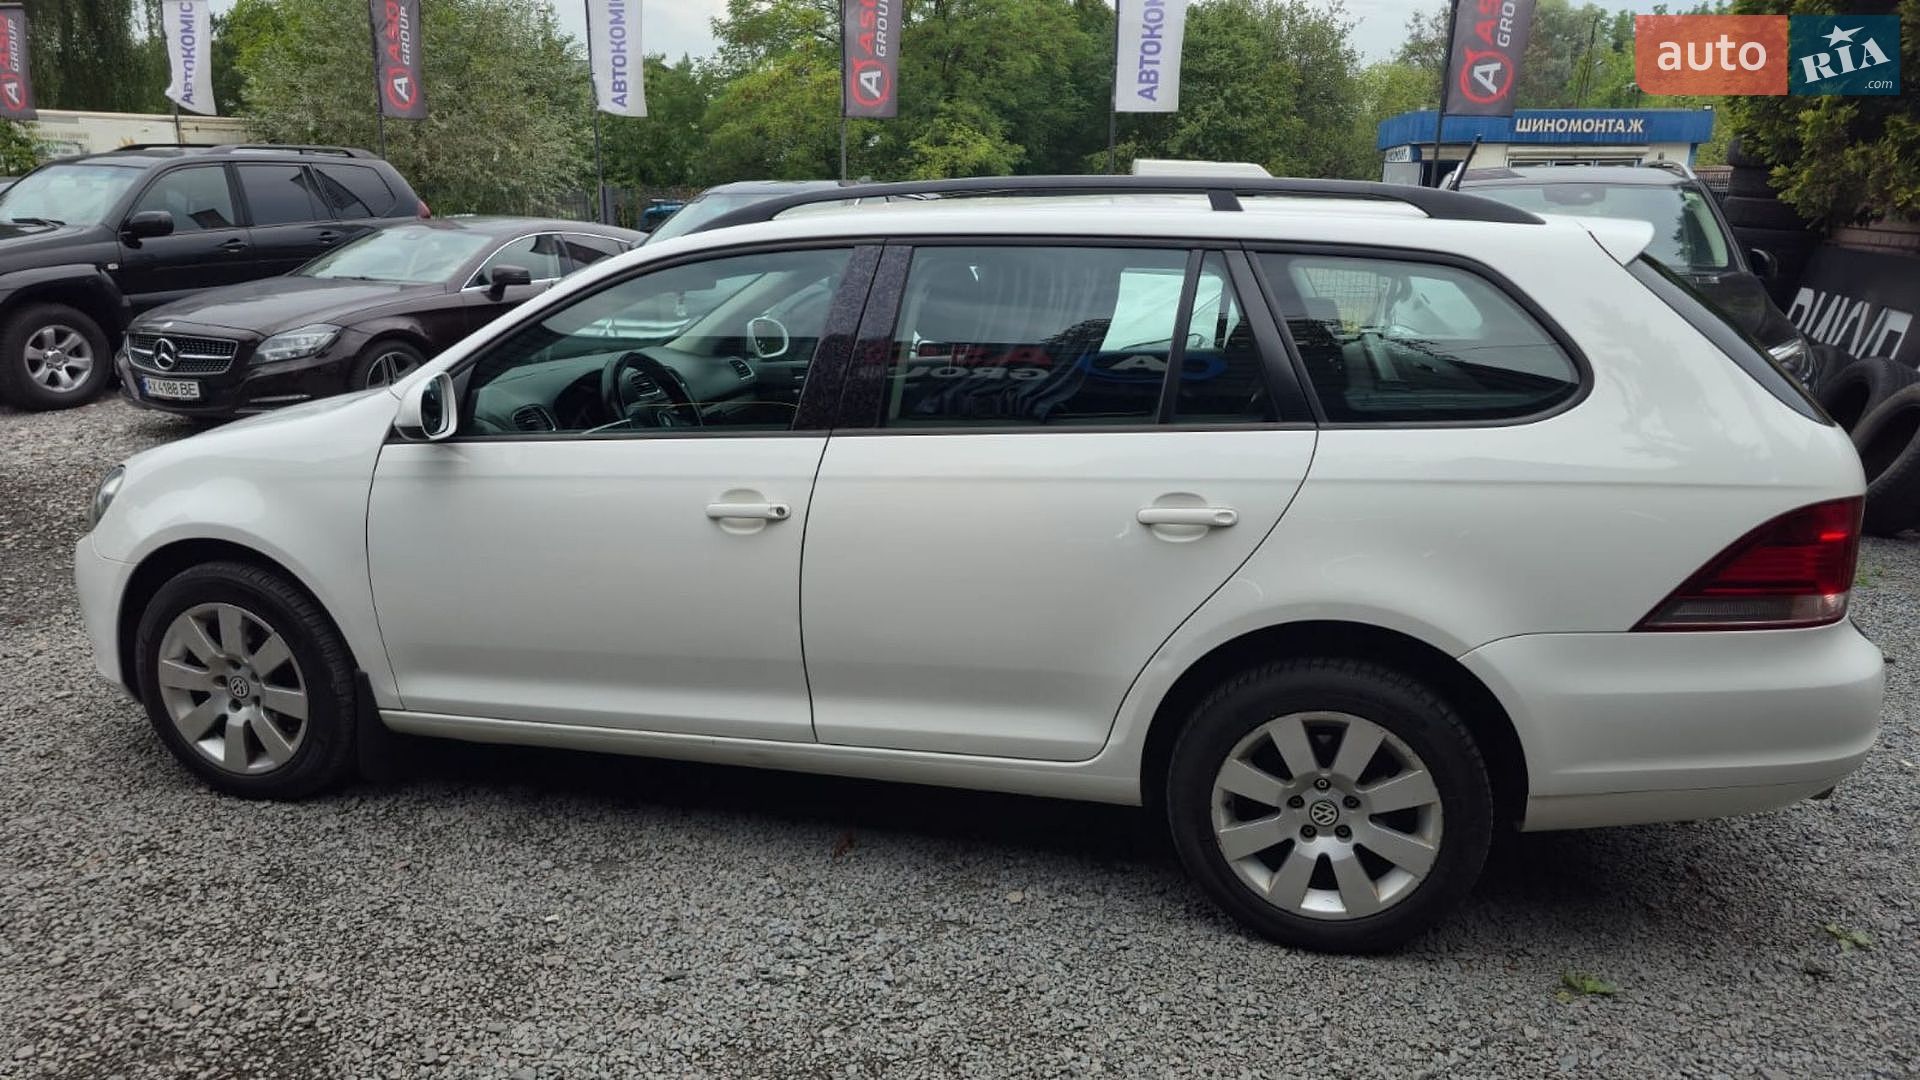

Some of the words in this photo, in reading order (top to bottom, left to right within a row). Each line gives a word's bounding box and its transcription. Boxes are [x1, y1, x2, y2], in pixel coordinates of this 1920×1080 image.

[400, 6, 411, 65] GROUP
[608, 0, 628, 107] АВТОКОМІ
[875, 0, 889, 57] GROU
[1515, 118, 1644, 133] ШИНОМОНТАЖ
